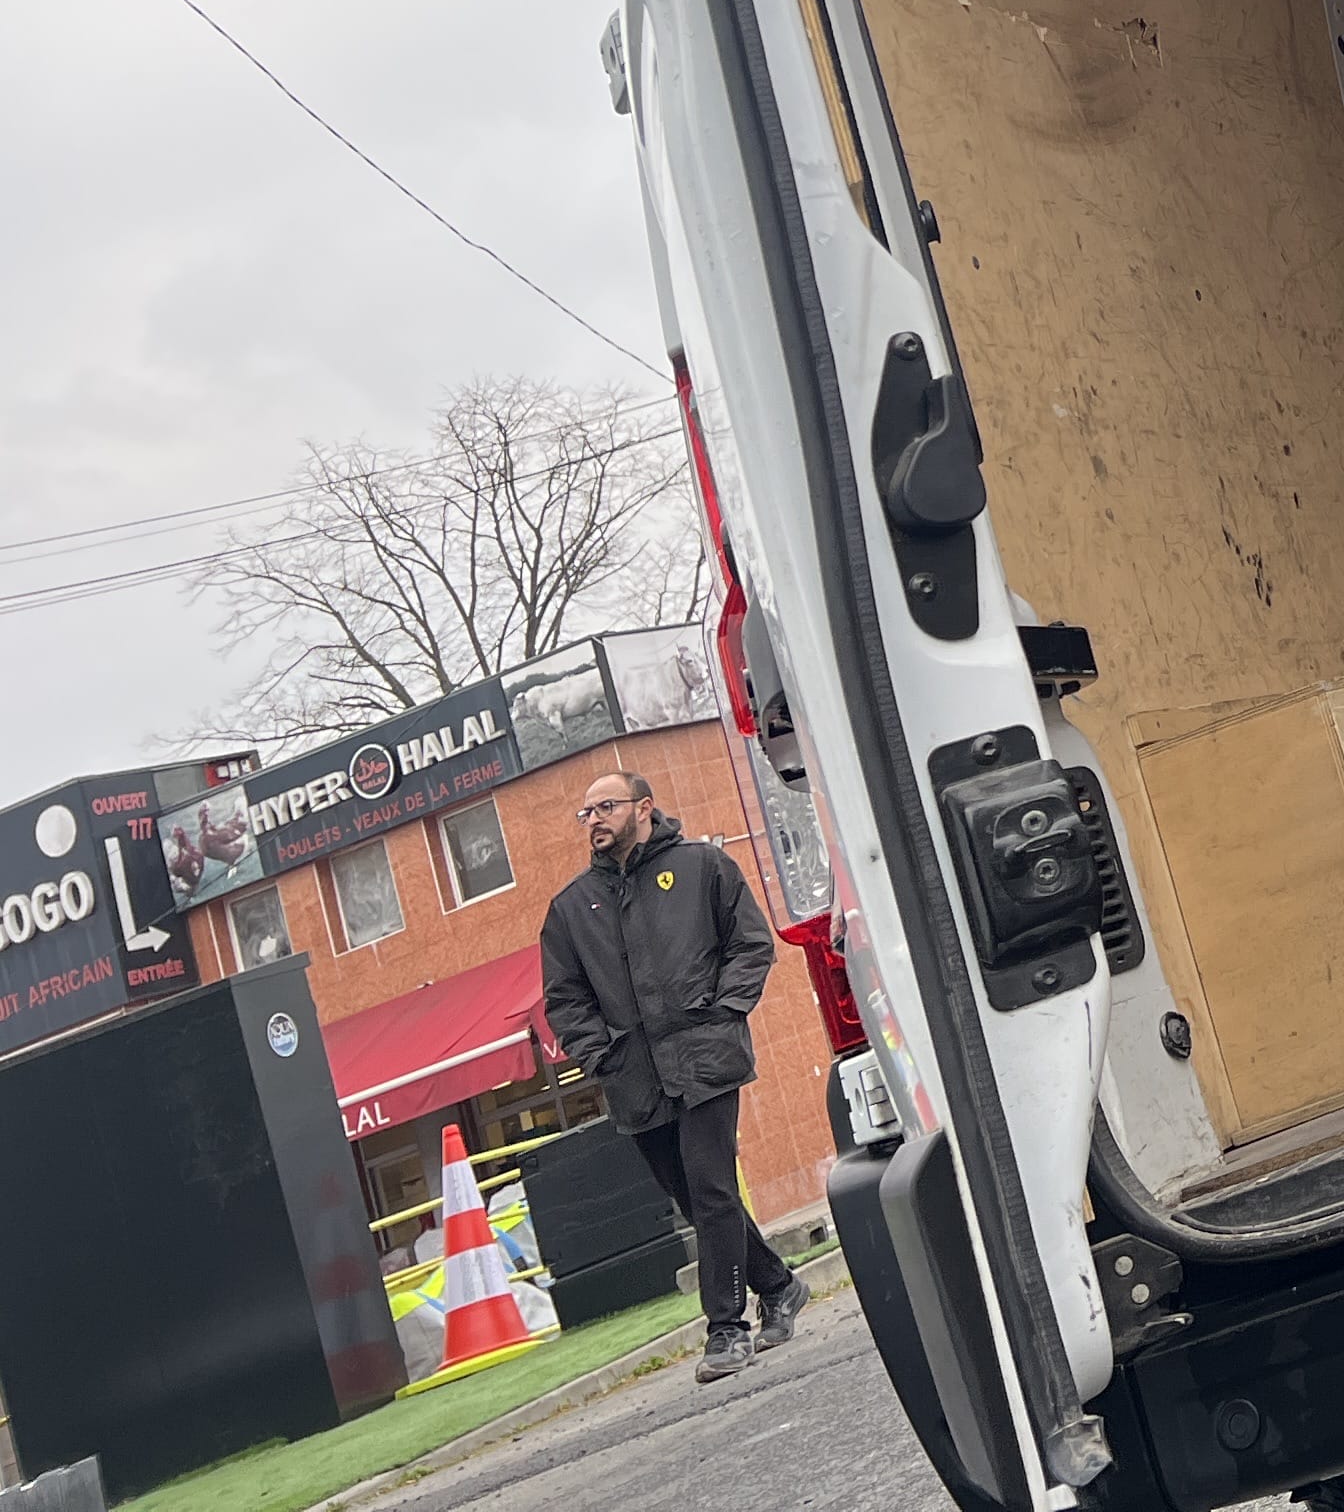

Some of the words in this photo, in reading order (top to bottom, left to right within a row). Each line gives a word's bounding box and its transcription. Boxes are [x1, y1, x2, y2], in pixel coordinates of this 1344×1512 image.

[249, 770, 353, 835] HYPER
[397, 710, 507, 775] HALAL
[92, 791, 148, 815] OUVERT
[278, 825, 342, 863] POULETS
[353, 801, 402, 833] VEAUX
[405, 792, 426, 812] DE
[431, 781, 450, 802] LA
[454, 759, 504, 793] FERME
[29, 956, 114, 1009] AFRICAIN
[128, 958, 185, 987] ENTRÉE
[341, 1101, 391, 1138] LAL
